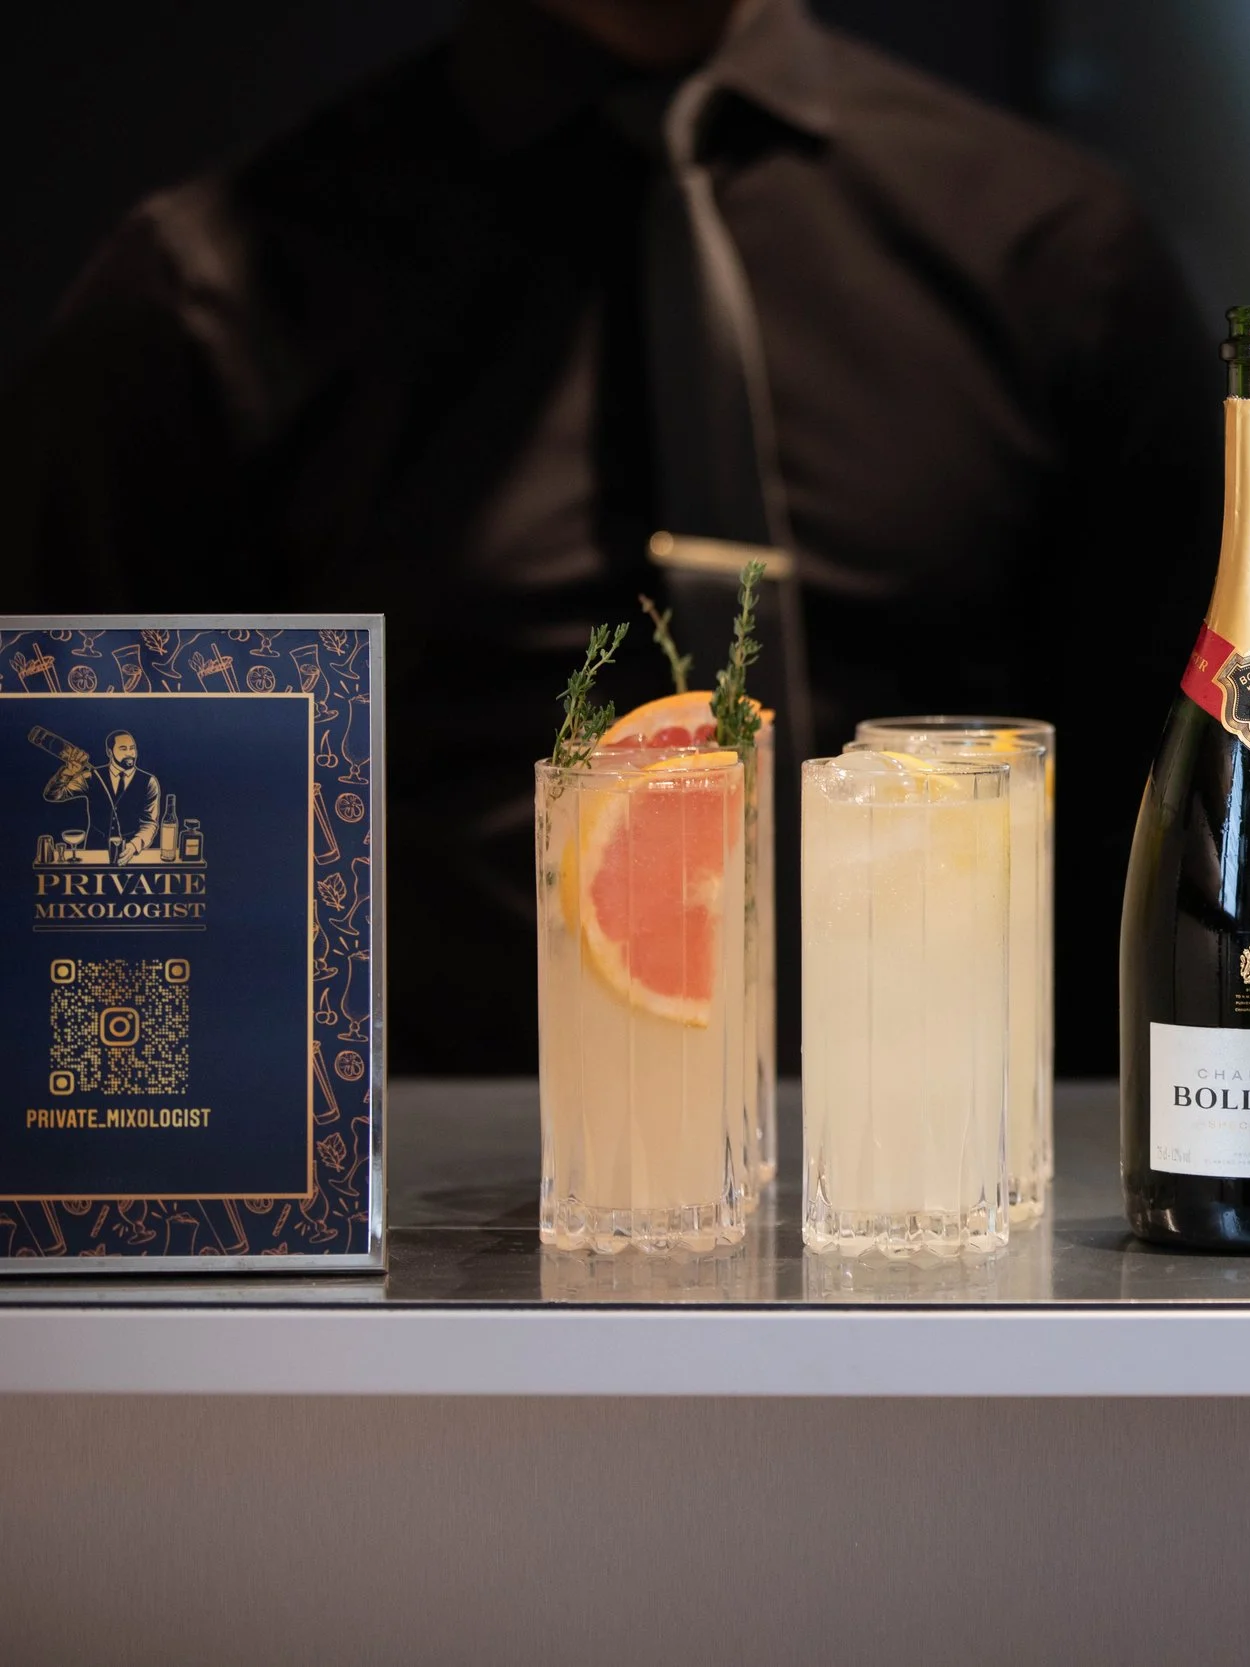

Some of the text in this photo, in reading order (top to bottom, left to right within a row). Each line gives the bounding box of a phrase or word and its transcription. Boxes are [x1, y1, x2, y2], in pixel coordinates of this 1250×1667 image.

[35, 873, 206, 896] PRIVATE
[35, 902, 206, 919] MIXOLOGIST
[26, 1108, 211, 1128] PRIVATE_MIXOLOGIST
